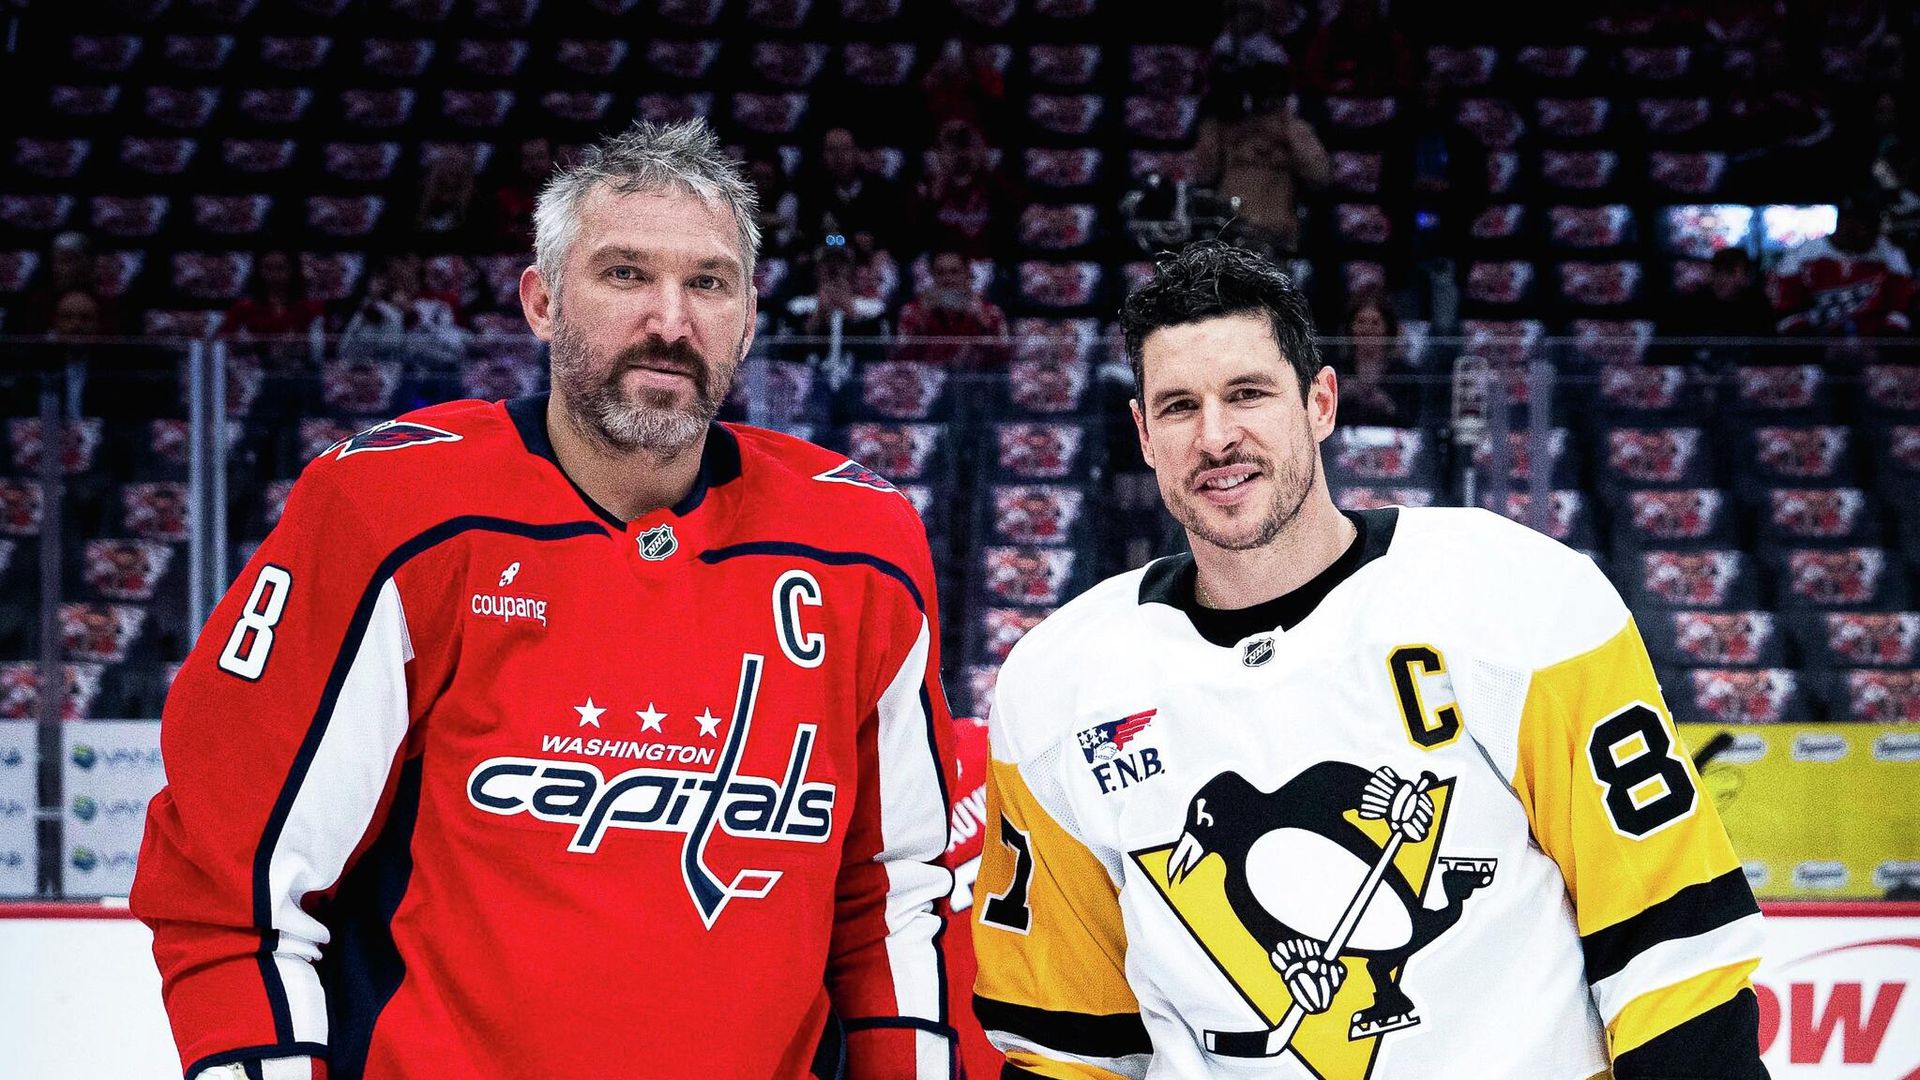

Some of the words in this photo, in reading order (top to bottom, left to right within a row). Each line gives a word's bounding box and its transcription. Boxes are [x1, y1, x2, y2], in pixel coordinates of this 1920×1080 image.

[648, 534, 667, 555] NHL
[217, 562, 293, 682] 8
[472, 594, 547, 627] coupang
[772, 569, 825, 668] C
[1249, 643, 1269, 663] NHL
[1386, 643, 1464, 752] C
[541, 735, 715, 765] WASHINGTON
[1091, 748, 1165, 795] F.N.B.
[1585, 700, 1699, 841] 8
[467, 653, 836, 930] capitals
